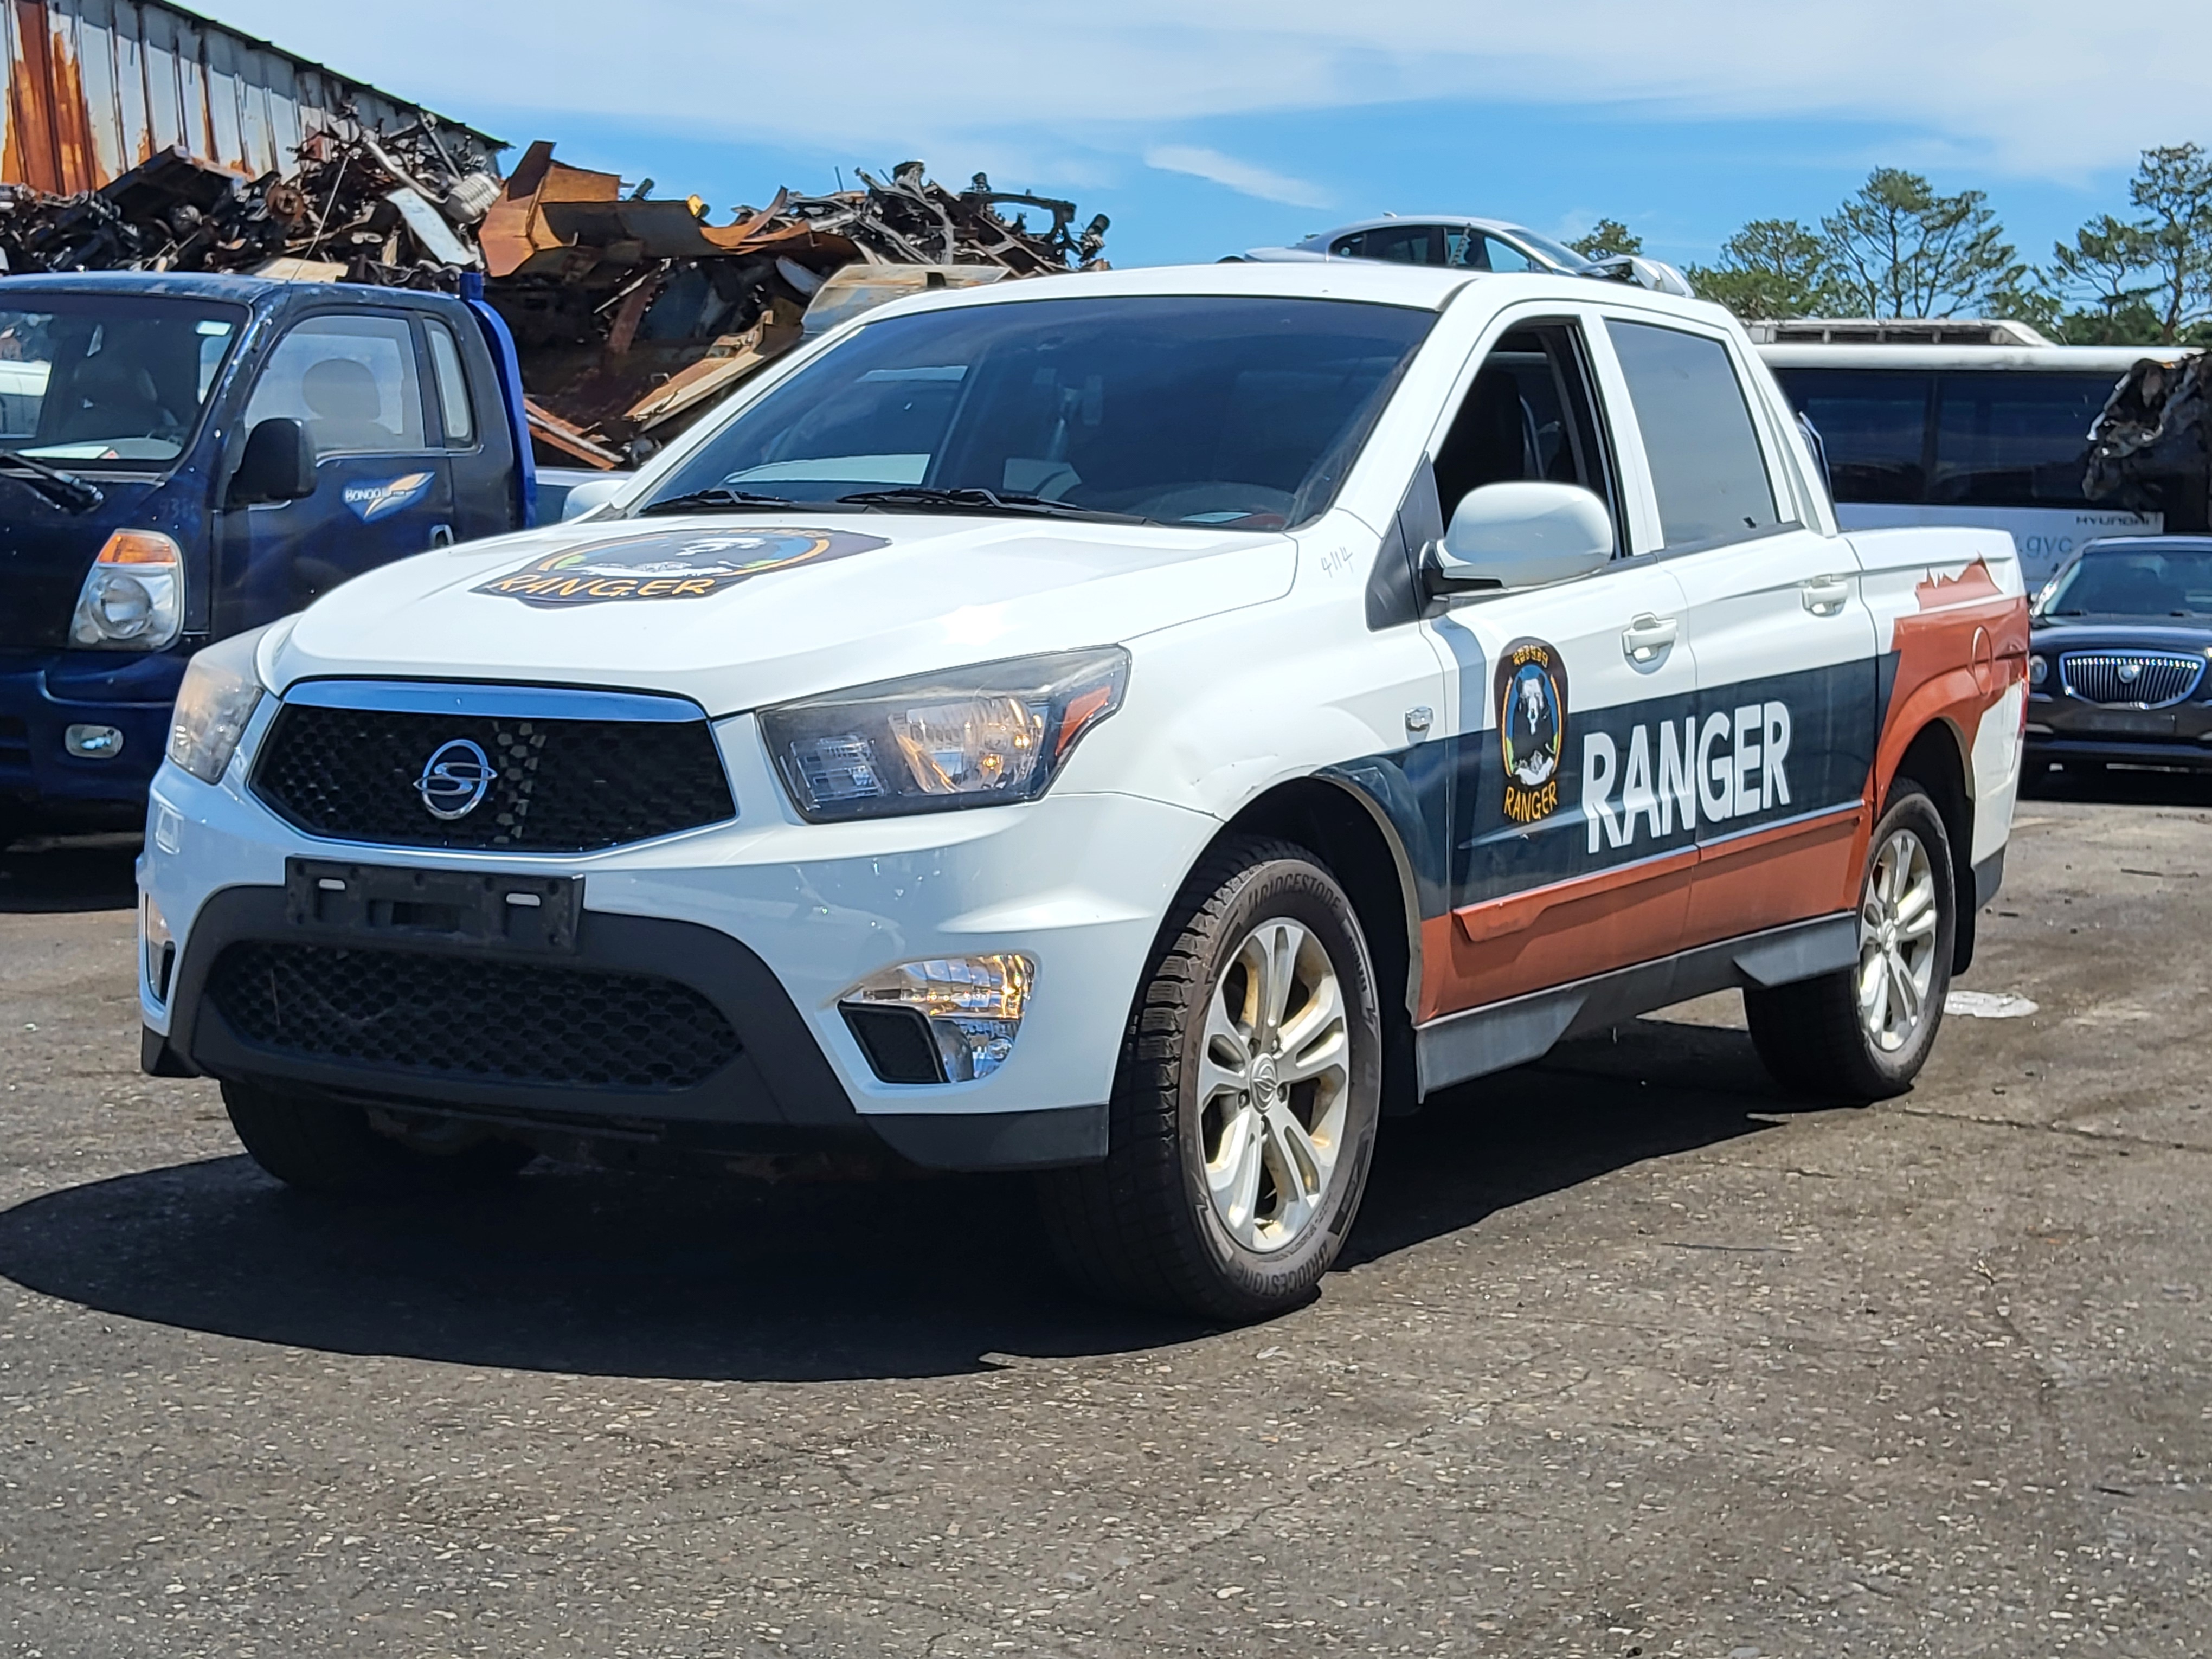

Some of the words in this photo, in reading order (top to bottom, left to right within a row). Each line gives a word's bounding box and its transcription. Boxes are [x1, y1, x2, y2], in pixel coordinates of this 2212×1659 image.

[1321, 546, 1353, 578] 4114
[486, 574, 715, 597] RANGER
[1582, 701, 1790, 854] RANGER
[1503, 781, 1558, 823] RANGER
